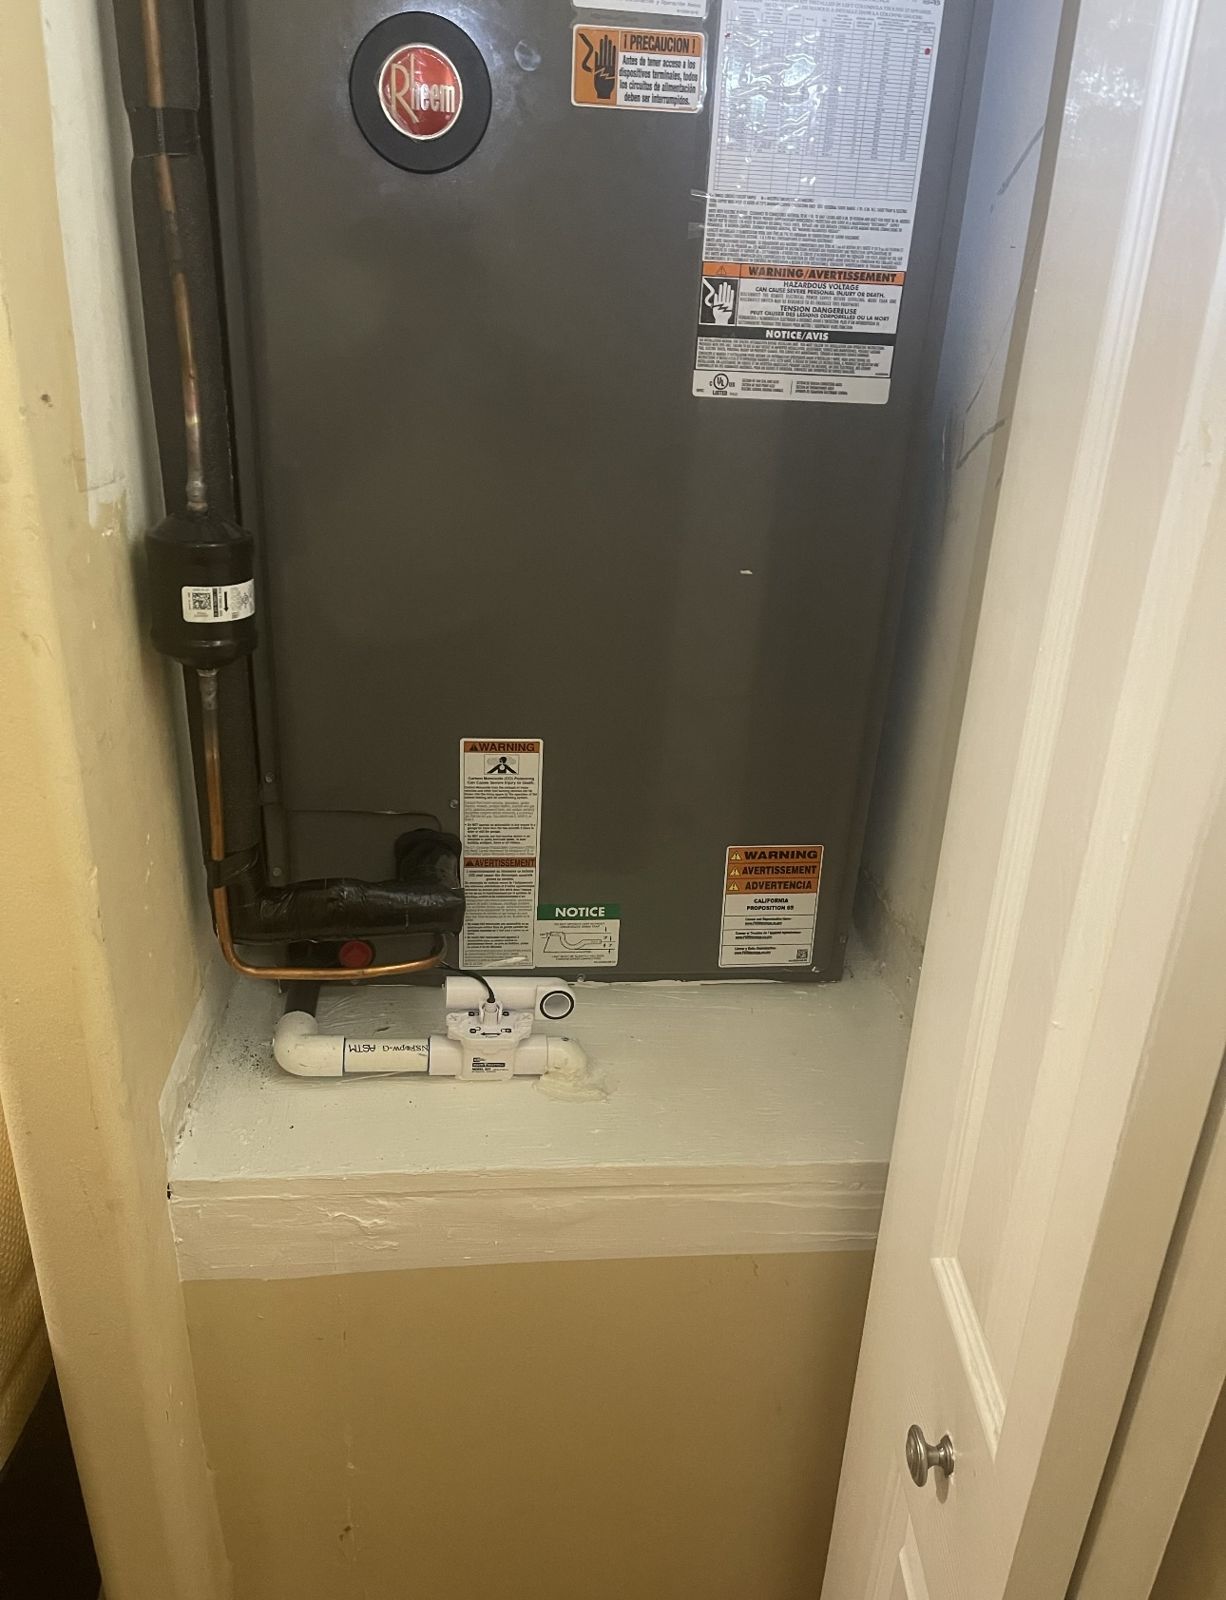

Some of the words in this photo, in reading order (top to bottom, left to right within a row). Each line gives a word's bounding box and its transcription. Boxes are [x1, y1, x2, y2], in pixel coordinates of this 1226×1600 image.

[630, 35, 690, 53] PRECAUCION
[622, 55, 638, 65] Antes
[639, 56, 646, 66] de
[647, 57, 661, 67] tener
[662, 58, 681, 68] acceso
[687, 59, 696, 69] los
[619, 67, 651, 79] dispositivos
[652, 70, 682, 81] terminales,
[683, 71, 698, 82] todos
[391, 53, 456, 123] Rheem
[619, 80, 628, 89] los
[629, 80, 652, 91] circuitos
[653, 82, 661, 91] de
[624, 92, 640, 102] deben
[642, 94, 651, 103] ser
[651, 93, 691, 106] interrumpidos.
[748, 266, 897, 282] WARNING/AVERTISSEMENT
[783, 281, 827, 290] HAZARDOUS
[828, 282, 859, 291] VOLTAGE
[807, 288, 835, 296] PERSONAL
[780, 304, 810, 313] TENSION
[812, 306, 857, 315] DANGEREUSE
[765, 329, 829, 341] NOTICE/AVIS
[480, 743, 534, 752] WARNING
[744, 850, 818, 860] WARNING
[475, 858, 535, 867] AVERTISSEMENT
[742, 866, 817, 875] AVERTISSEMENT
[745, 881, 812, 890] ADVERTENCIA
[555, 906, 606, 917] NOTICE
[348, 1044, 376, 1053] ASTM
